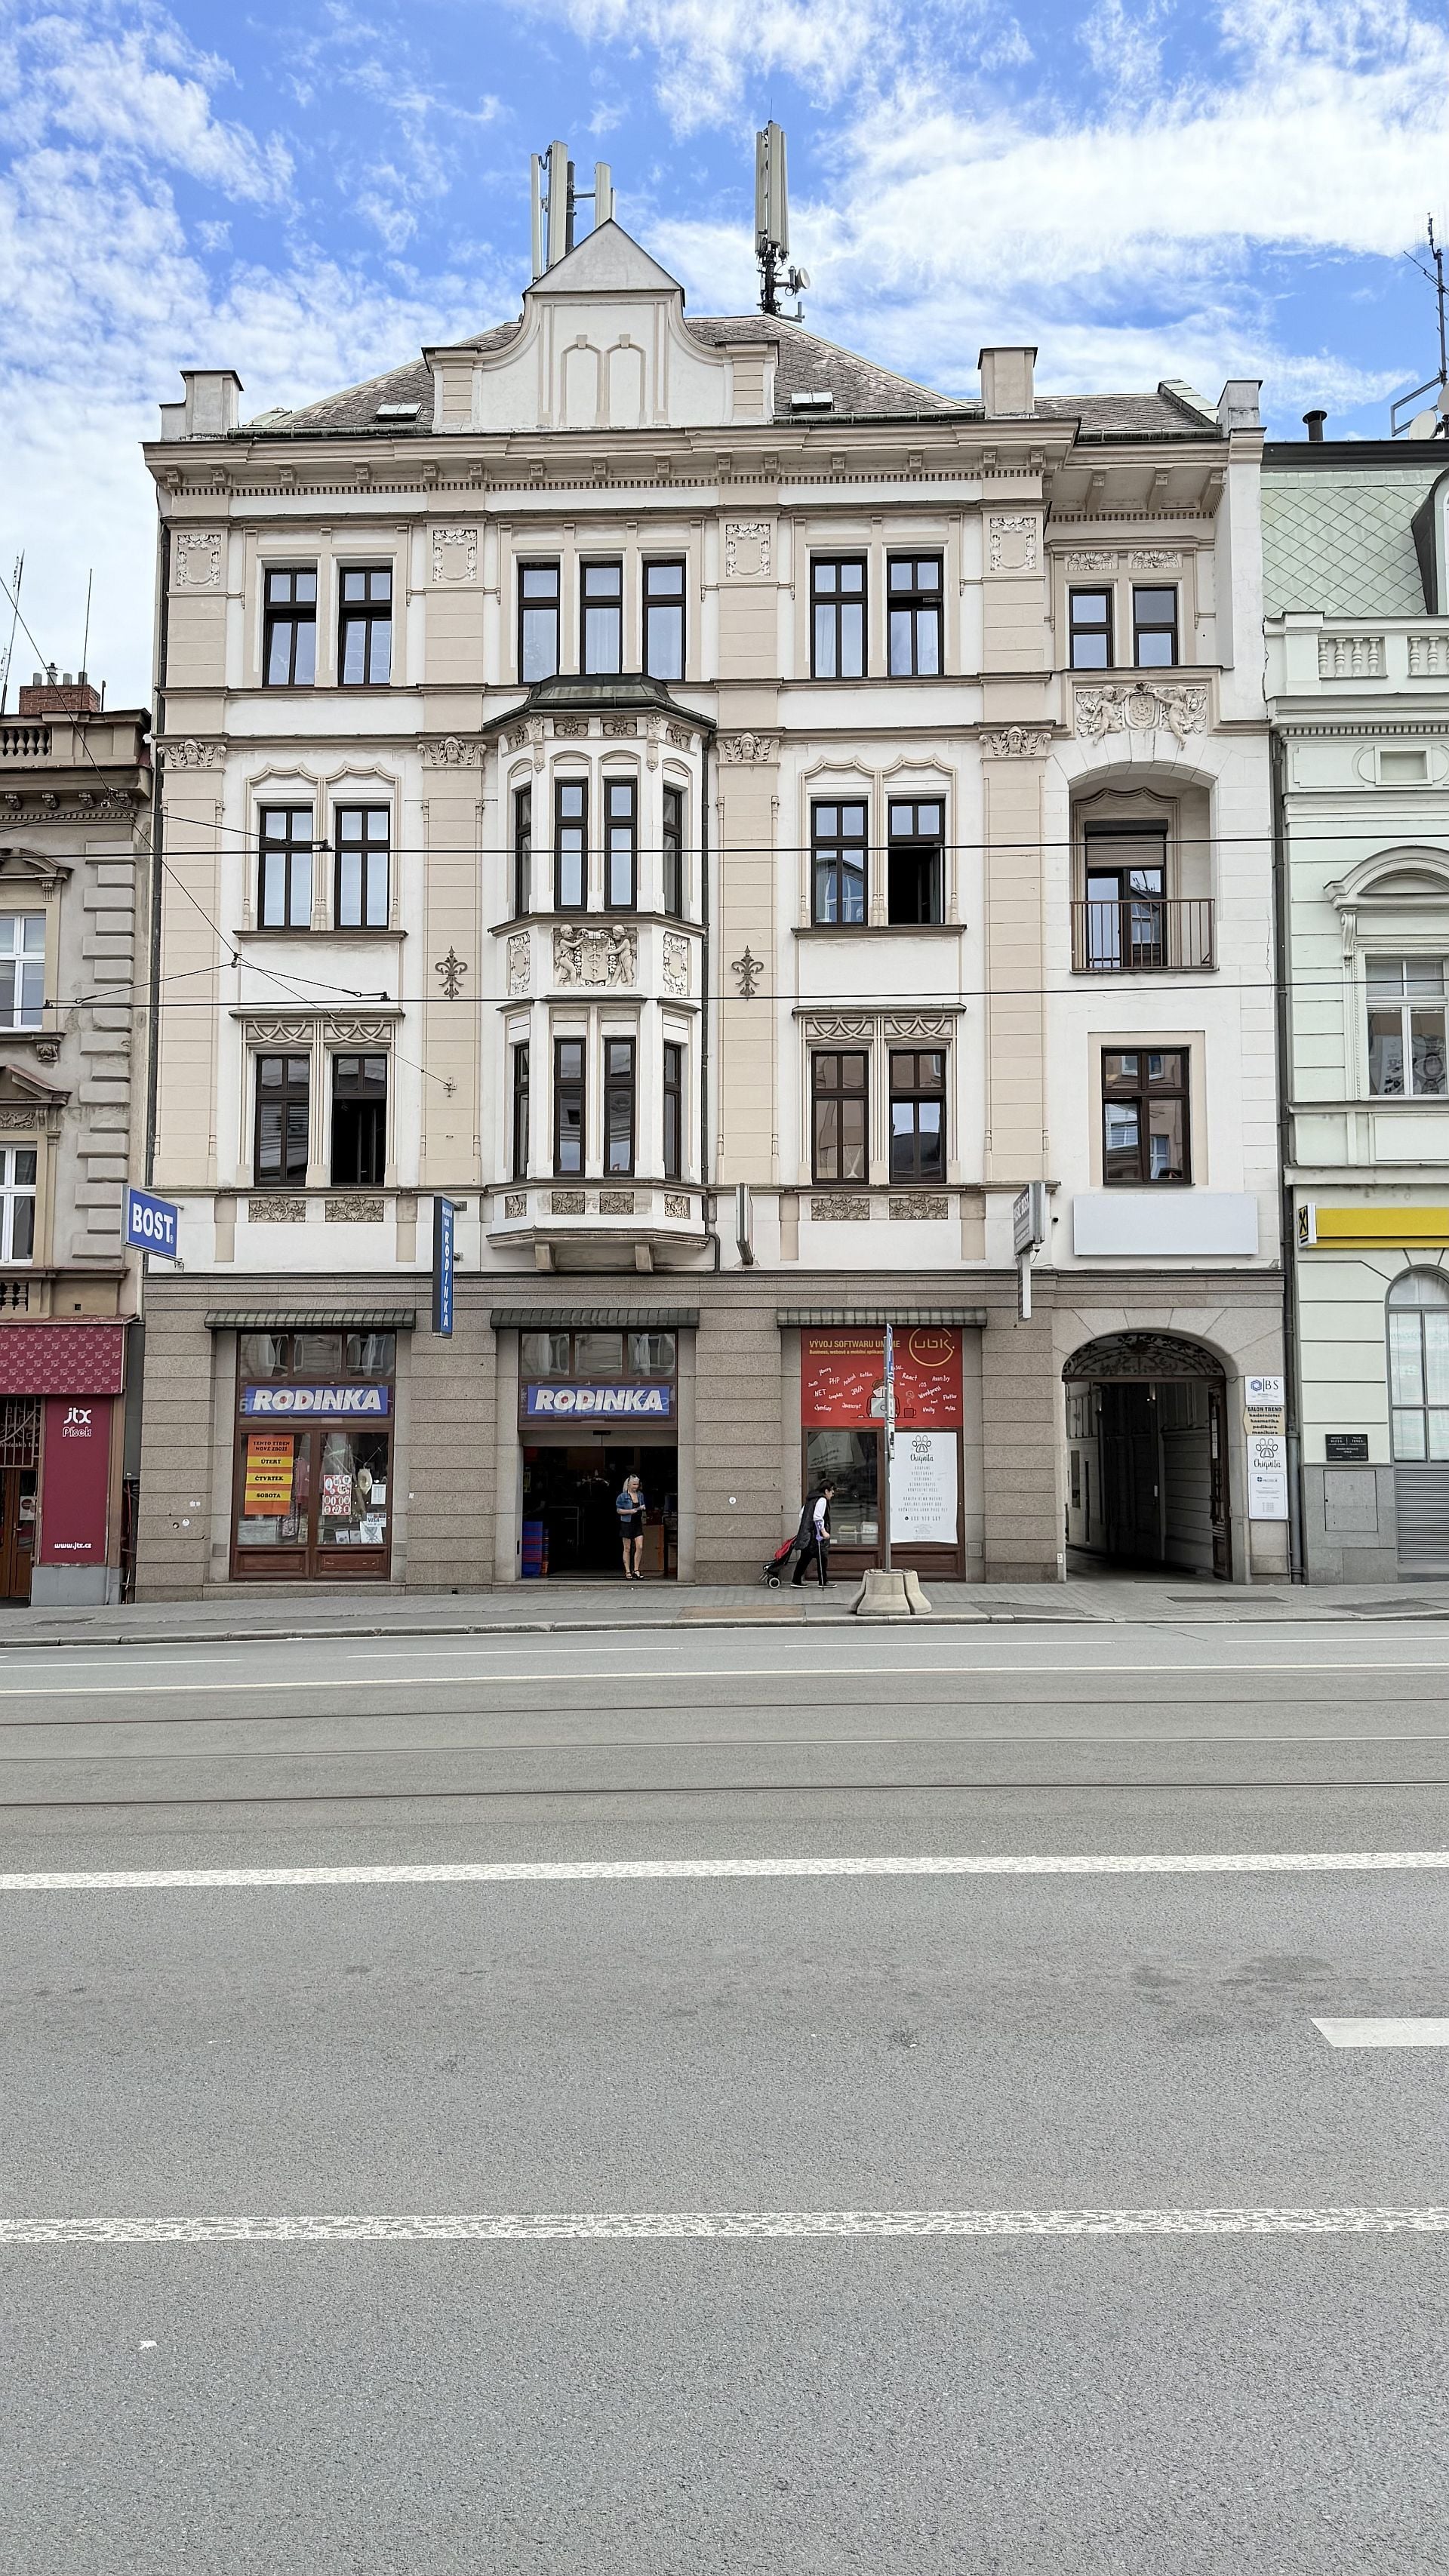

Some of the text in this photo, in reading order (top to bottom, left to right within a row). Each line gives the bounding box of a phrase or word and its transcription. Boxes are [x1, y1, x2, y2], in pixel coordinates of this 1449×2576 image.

[809, 1339, 832, 1348] VÝVOJ
[834, 1340, 874, 1348] SOFTWARU
[829, 1376, 840, 1385] PHP
[902, 1372, 918, 1381] React
[253, 1390, 381, 1411] RODINKA
[535, 1390, 663, 1411] RODINKA
[63, 1407, 92, 1423] jtx
[54, 1542, 92, 1550] www.jtx.cz
